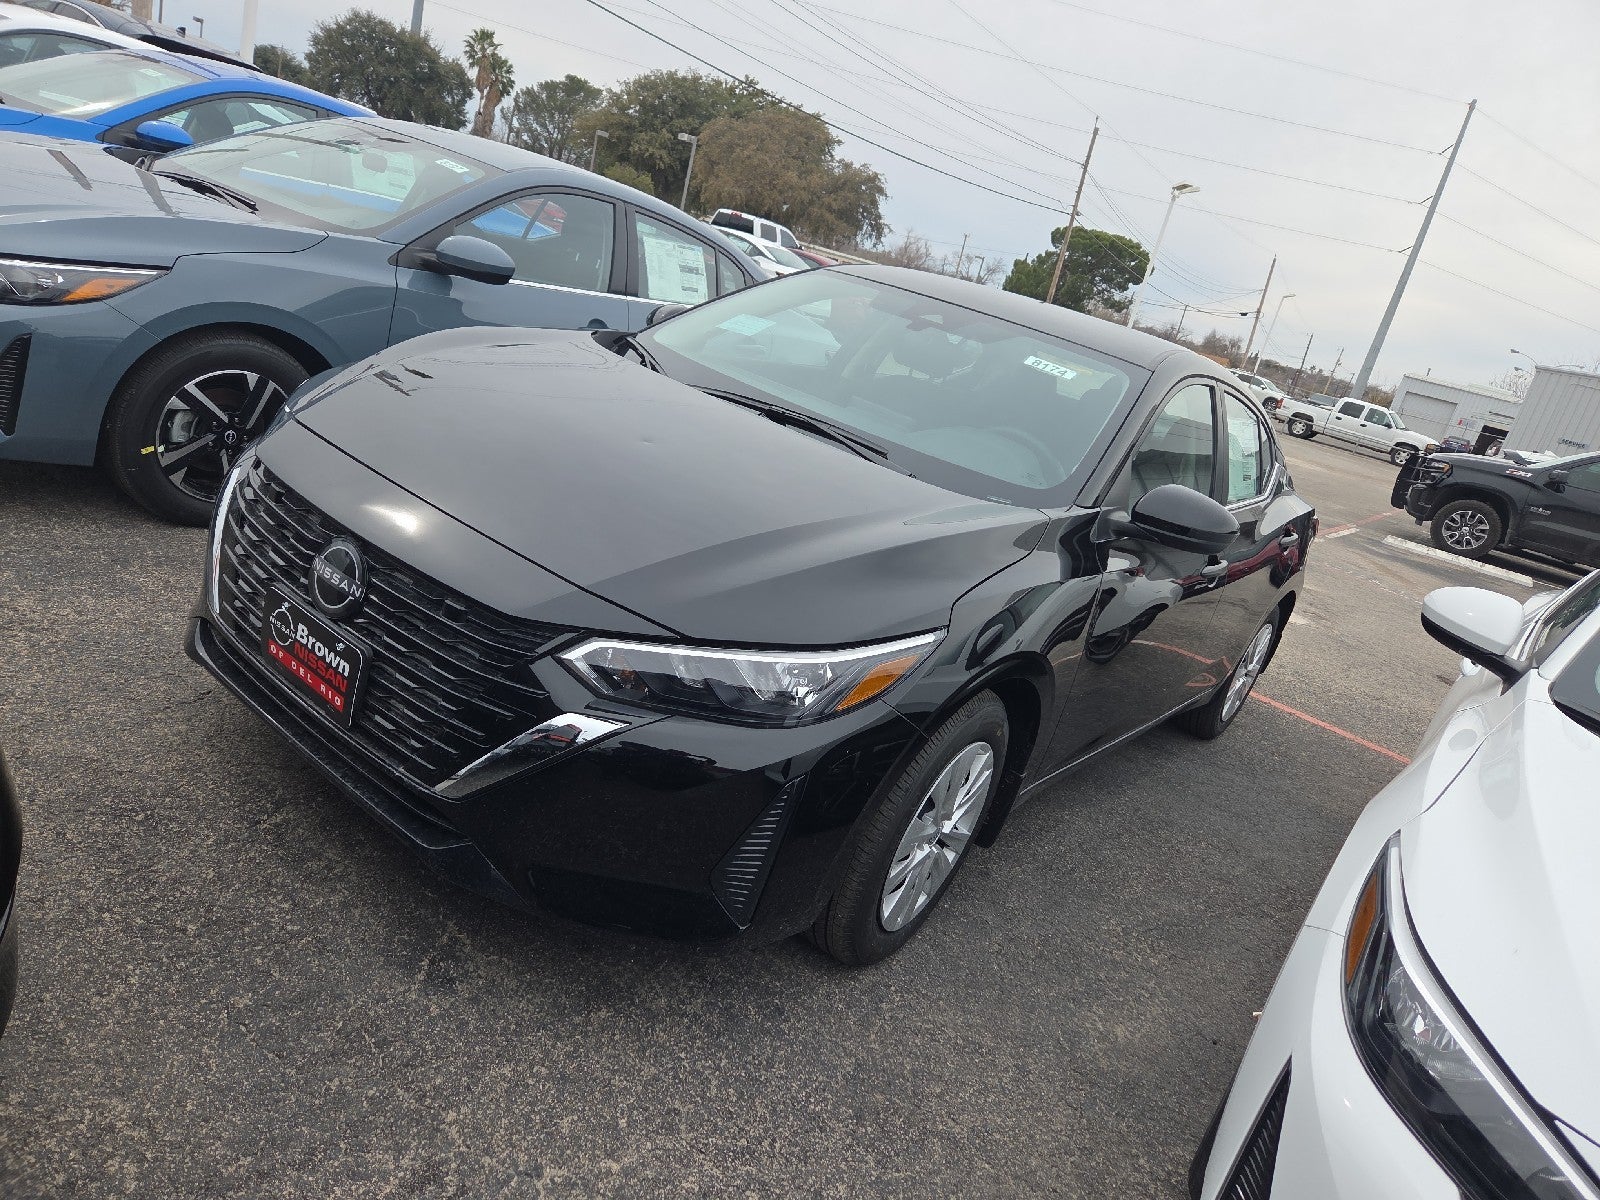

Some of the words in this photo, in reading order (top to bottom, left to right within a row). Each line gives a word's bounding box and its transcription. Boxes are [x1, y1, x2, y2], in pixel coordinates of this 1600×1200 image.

[1031, 359, 1068, 377] 8174
[1560, 438, 1586, 449] SERVICE
[312, 555, 362, 598] NISSAN
[269, 615, 296, 639] NISSAN
[294, 641, 348, 693] NISSAN
[296, 622, 350, 677] Brown
[291, 661, 313, 684] DEL
[320, 683, 341, 706] RIO
